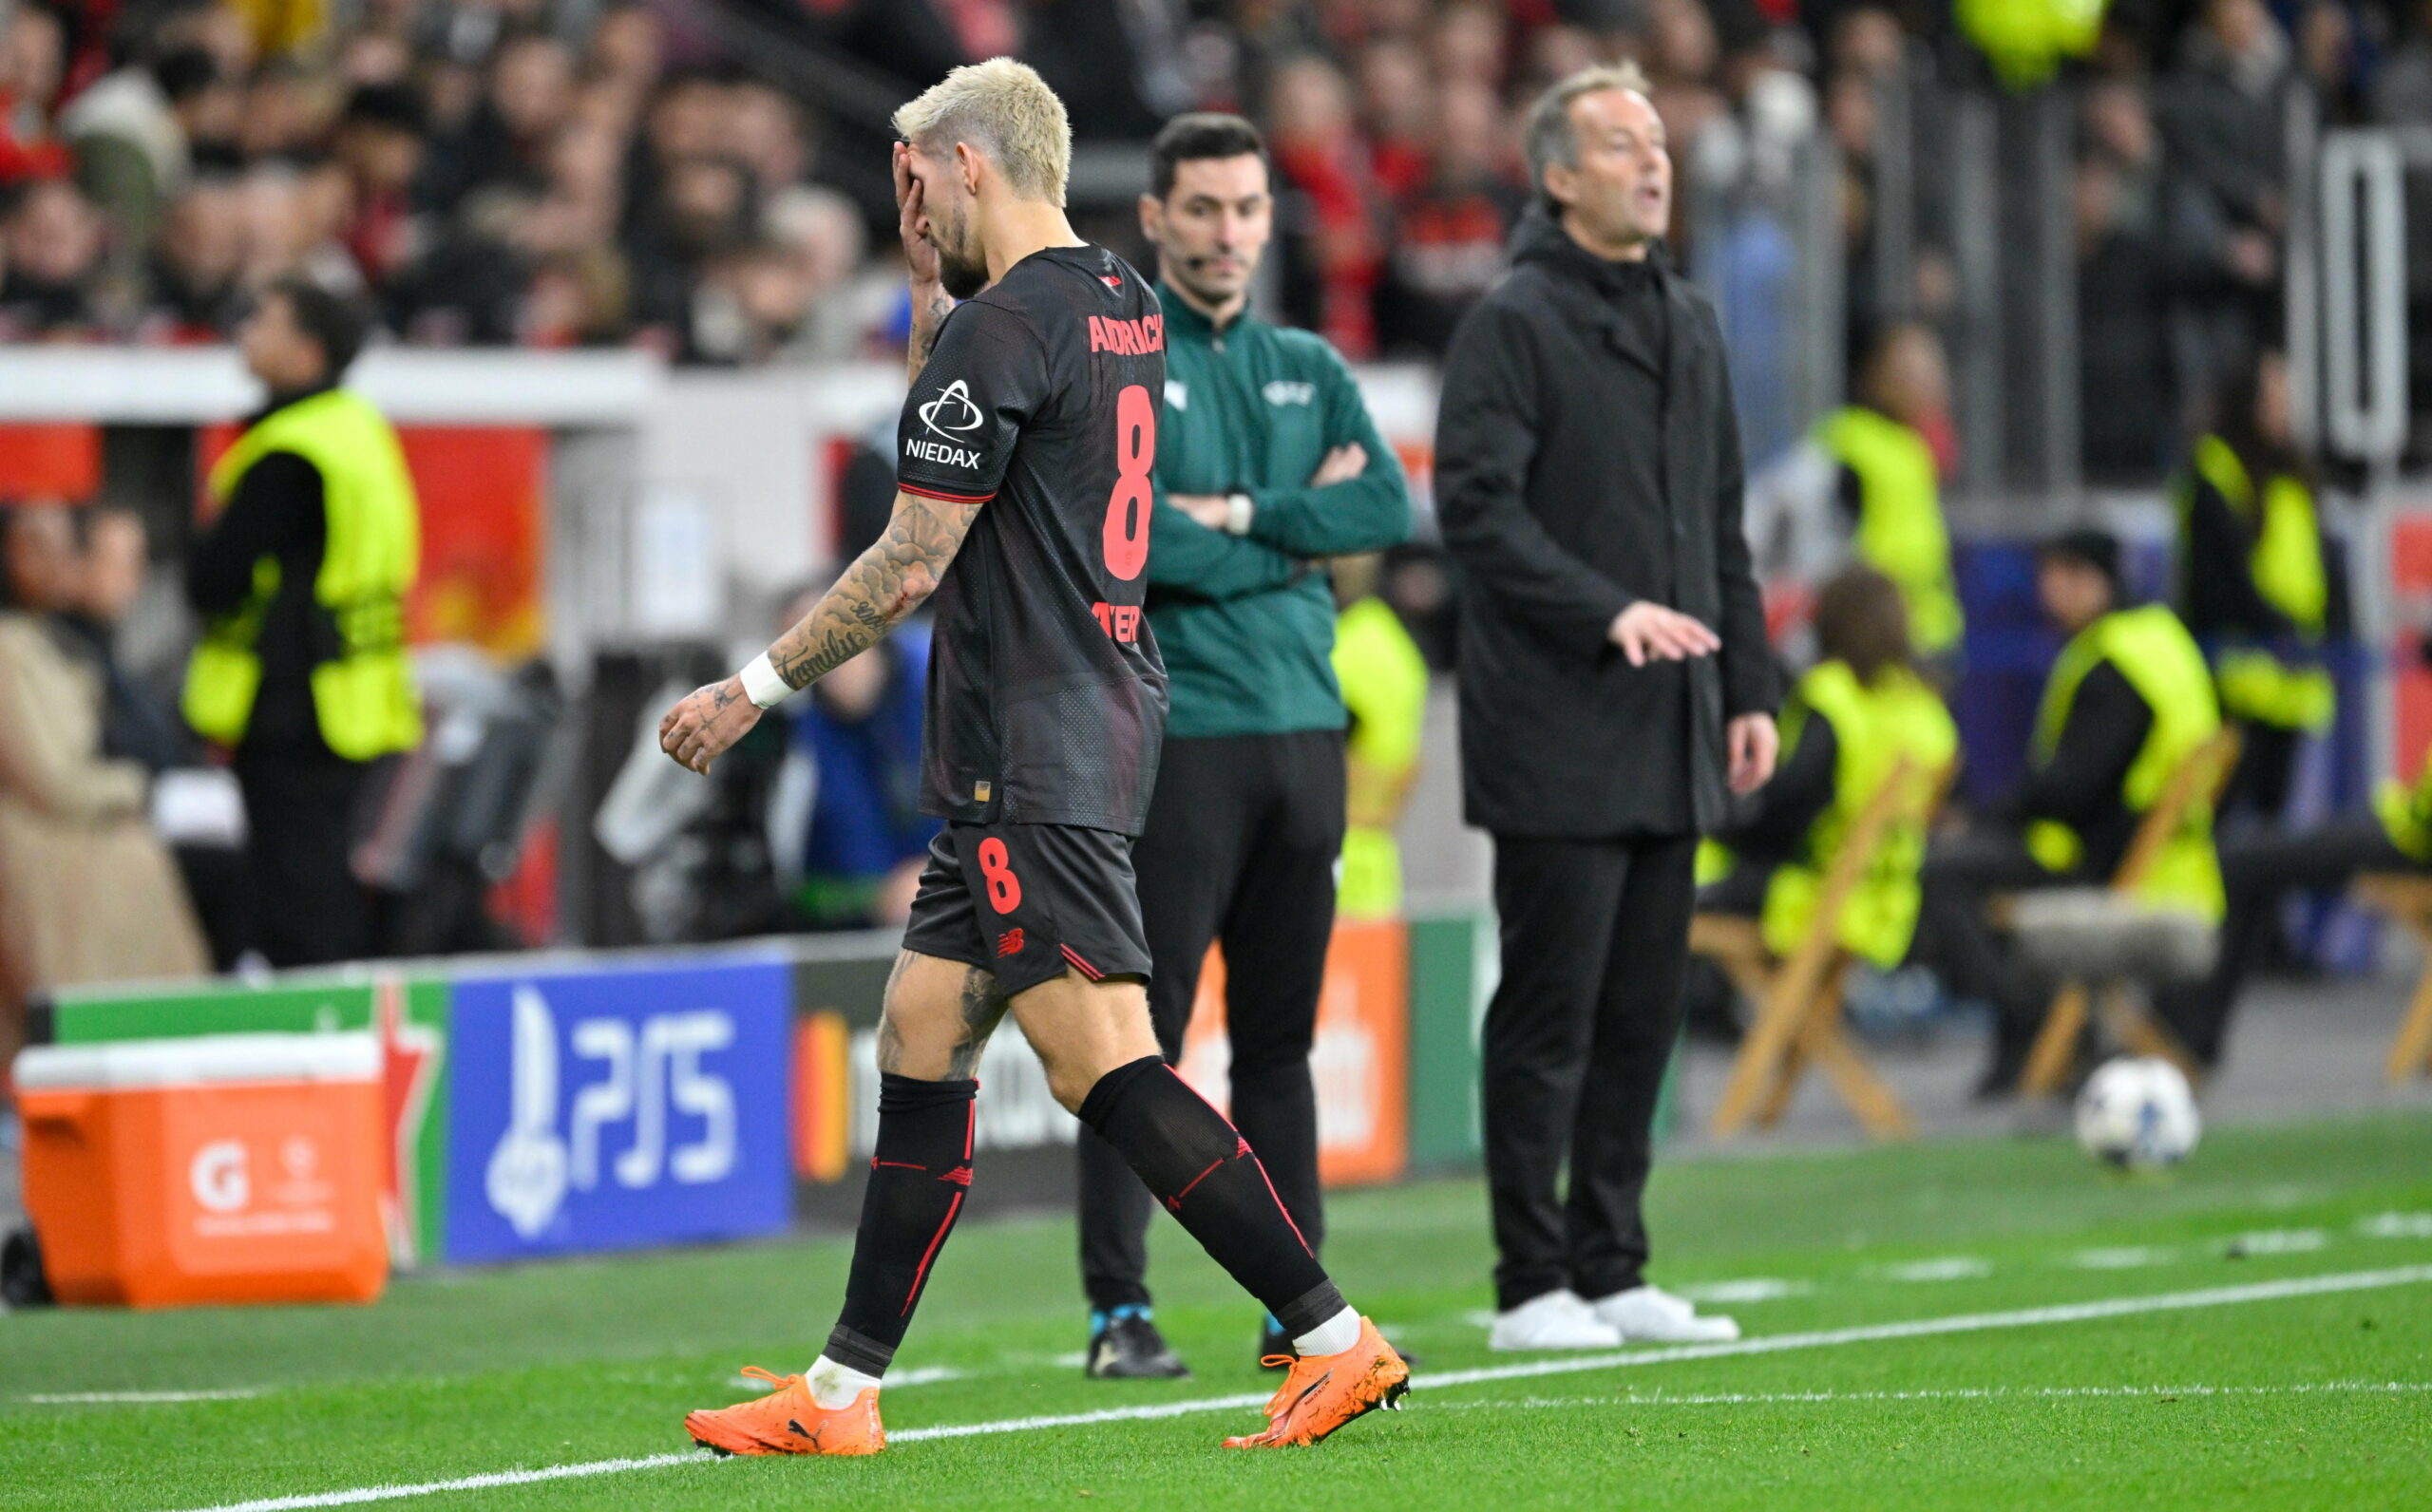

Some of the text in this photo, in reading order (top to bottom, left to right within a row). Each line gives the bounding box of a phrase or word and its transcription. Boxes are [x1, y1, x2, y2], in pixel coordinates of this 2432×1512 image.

[905, 438, 981, 470] NIEDAX
[1103, 385, 1155, 580] 8
[978, 837, 1021, 915] 8
[571, 1009, 737, 1191] PS5
[190, 1142, 250, 1212] G
